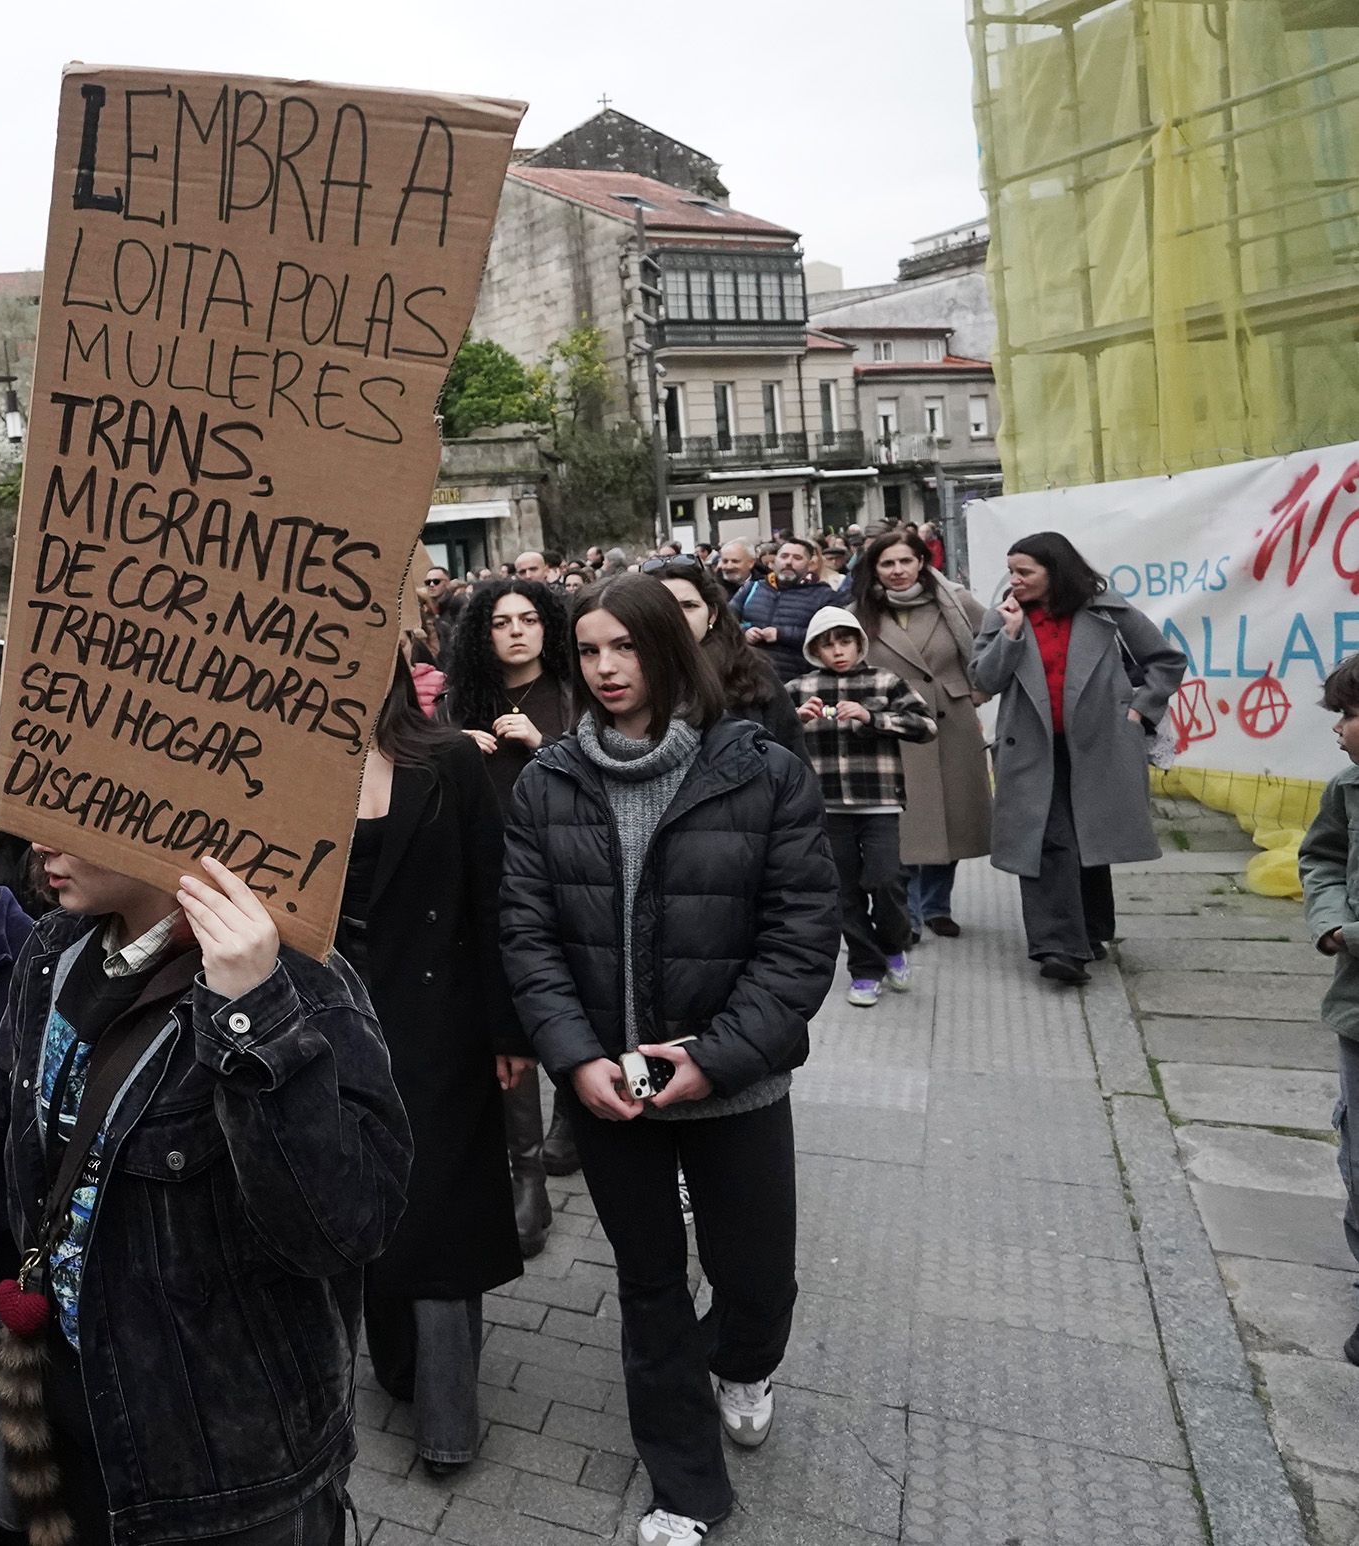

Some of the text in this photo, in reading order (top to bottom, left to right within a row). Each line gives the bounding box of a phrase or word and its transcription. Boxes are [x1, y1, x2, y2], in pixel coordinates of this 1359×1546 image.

[72, 83, 453, 247] LEMBRA A
[63, 227, 450, 360] LOITA POLAS
[51, 391, 275, 497] TRANS,
[62, 320, 406, 445] MULLERES
[35, 533, 361, 680] DE COR, NAIS,
[38, 465, 388, 628] MIGRANTES,
[1109, 555, 1231, 598] OBRAS
[11, 717, 73, 756] CON
[18, 661, 265, 799] SEN HOGAR,
[27, 600, 368, 756] TRABALLADORAS,
[2, 748, 338, 914] DISCAPACIDADE!
